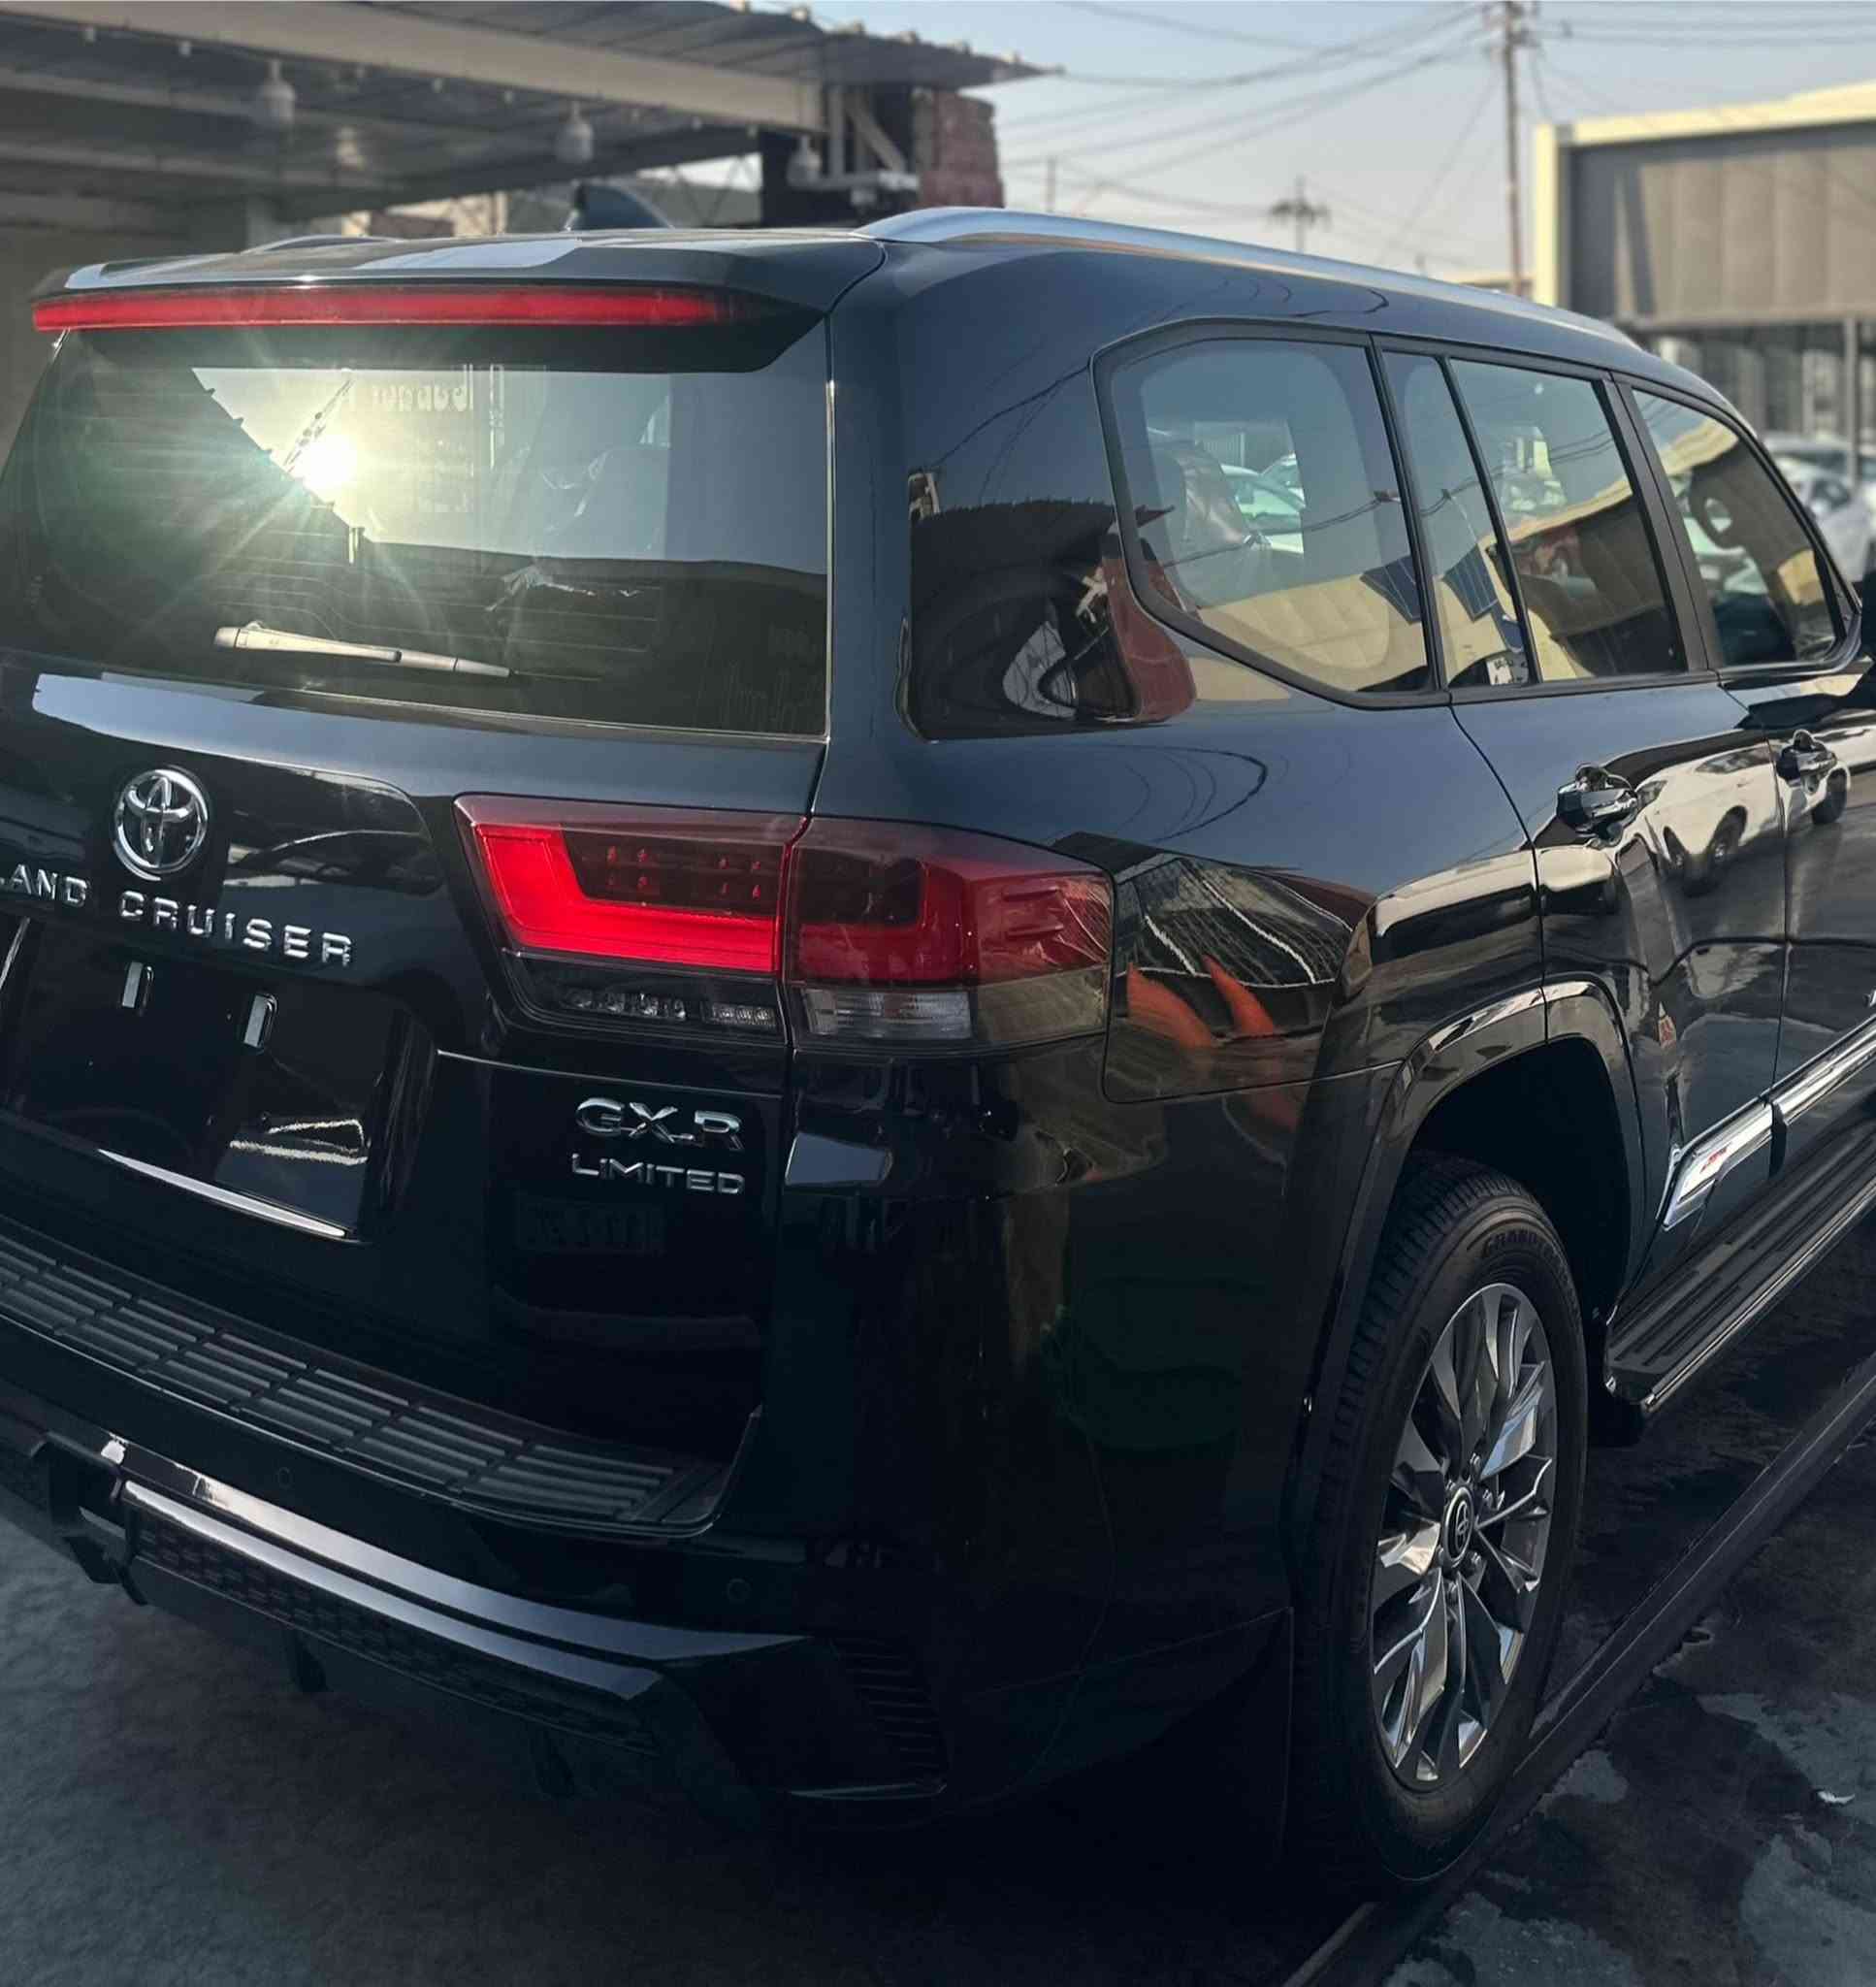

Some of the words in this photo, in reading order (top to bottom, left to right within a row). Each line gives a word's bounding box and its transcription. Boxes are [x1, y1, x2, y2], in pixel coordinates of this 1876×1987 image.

[0, 863, 90, 907] AND
[118, 890, 353, 967] CRUISER
[575, 1097, 744, 1151] GXR
[571, 1153, 746, 1194] LIMITED
